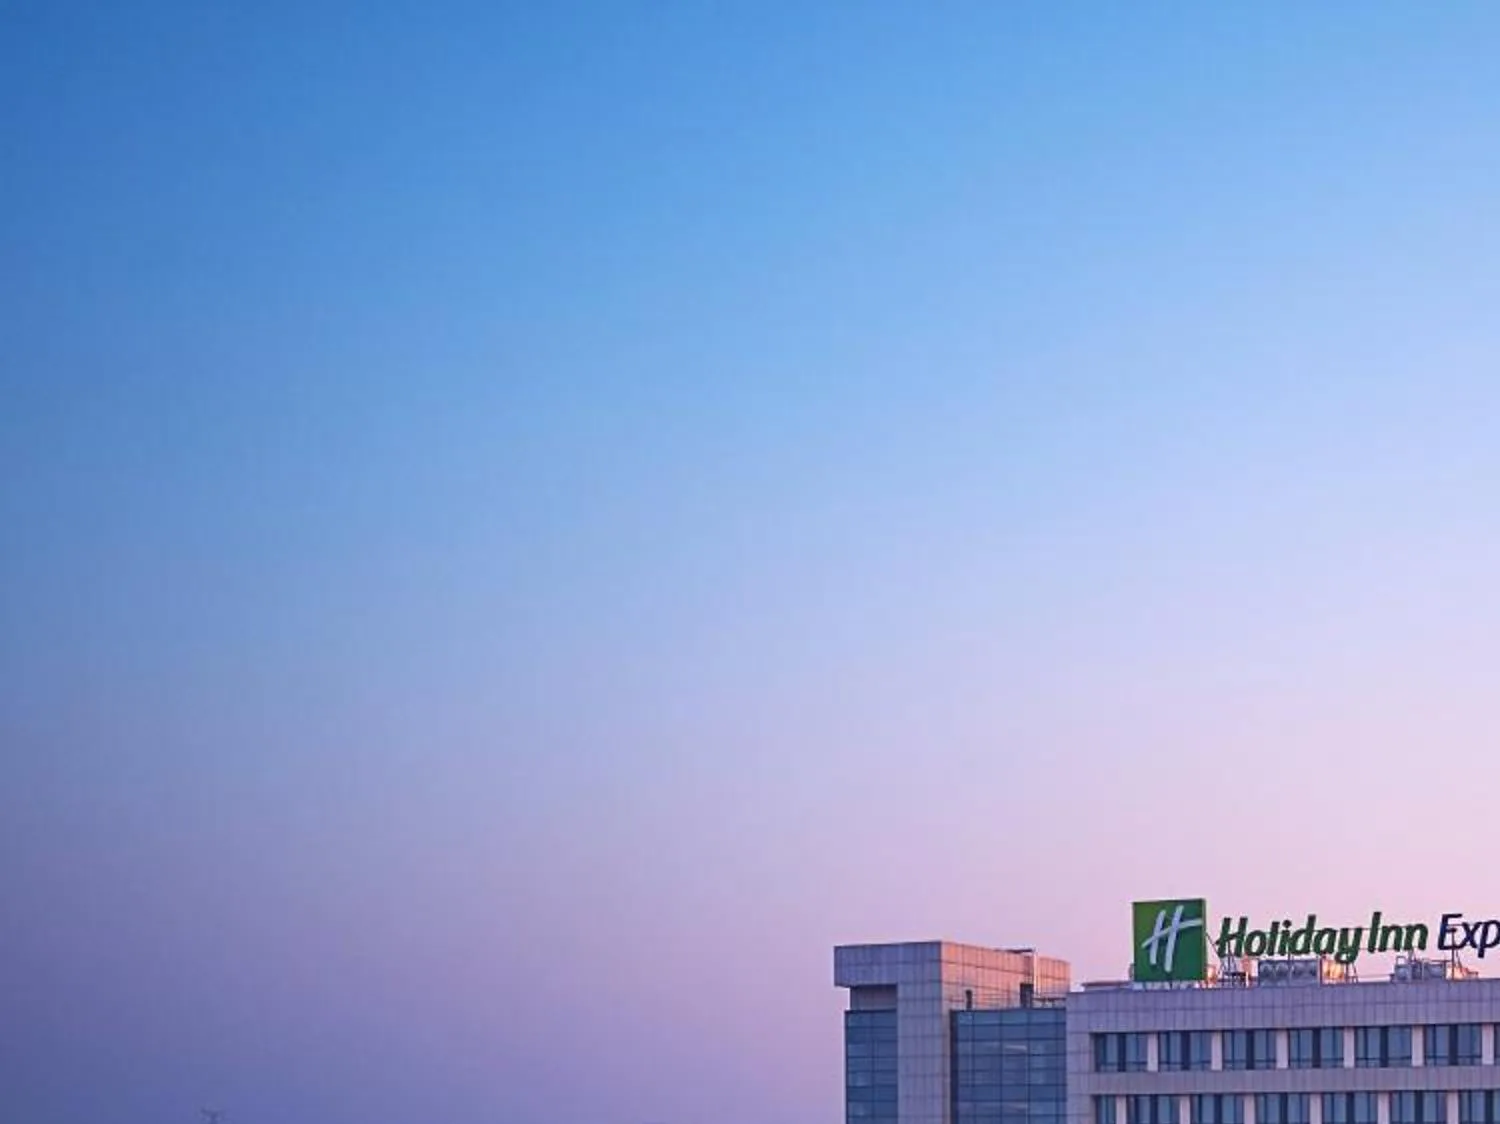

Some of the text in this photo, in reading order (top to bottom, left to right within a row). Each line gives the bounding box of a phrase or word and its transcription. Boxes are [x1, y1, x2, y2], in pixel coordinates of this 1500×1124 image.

[1141, 904, 1203, 973] H
[1215, 914, 1363, 964] Holiday
[1367, 911, 1429, 954] Inn
